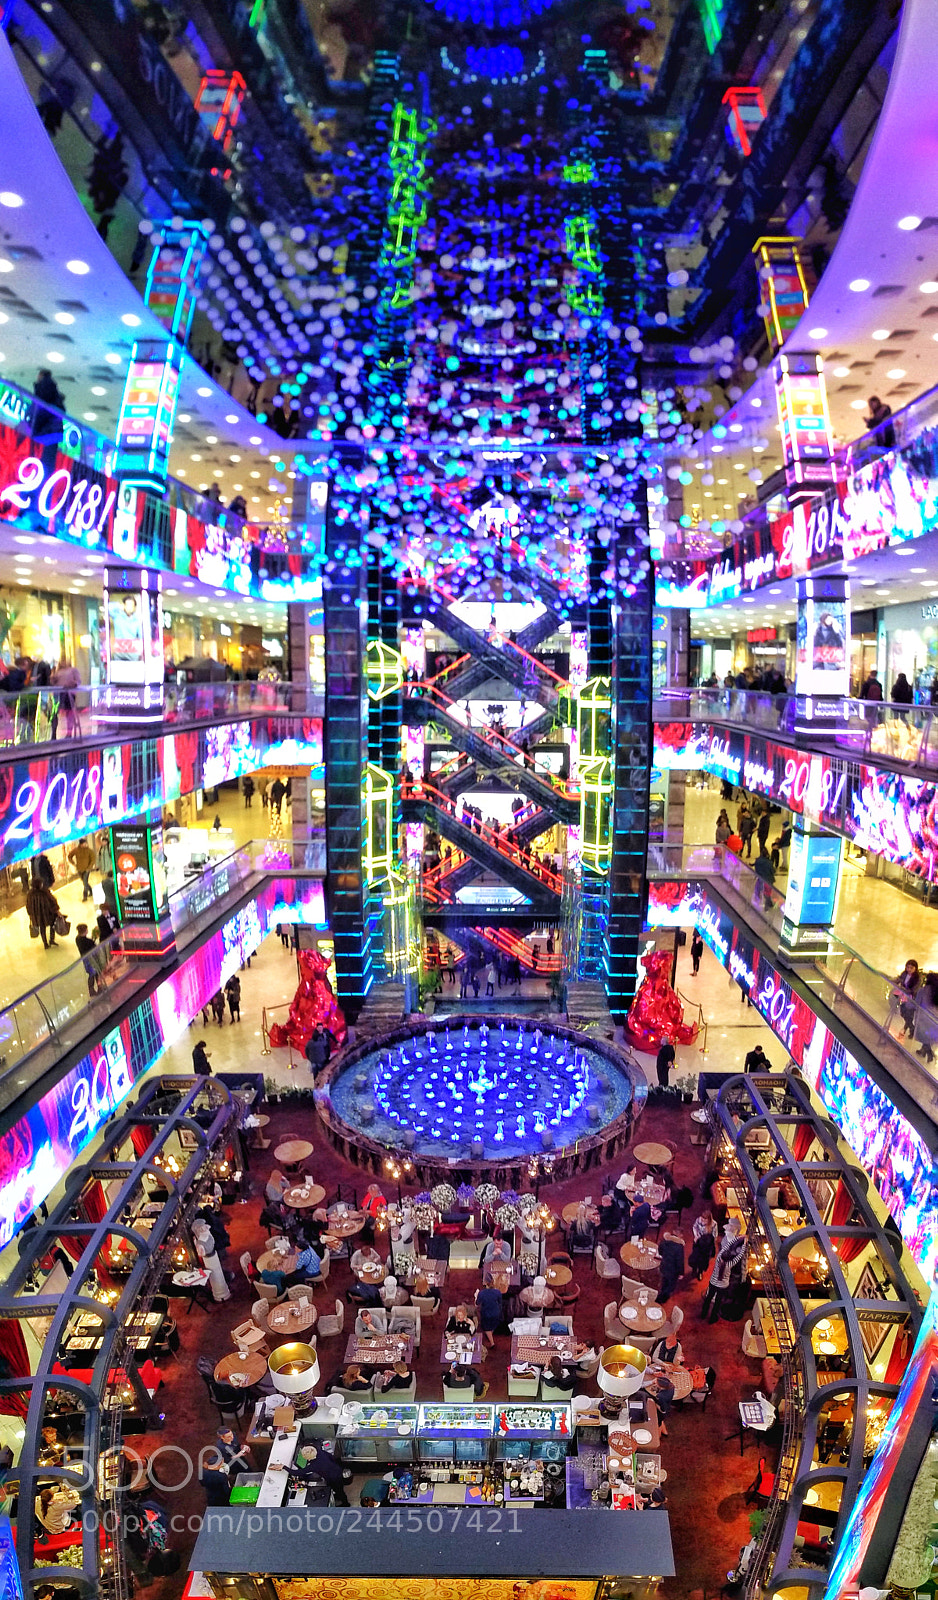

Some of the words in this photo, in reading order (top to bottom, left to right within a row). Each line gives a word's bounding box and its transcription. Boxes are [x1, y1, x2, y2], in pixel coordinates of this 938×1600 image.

[1, 457, 116, 533] 2018!
[4, 765, 101, 844] 2018
[9, 1307, 56, 1317] МОСКВА
[859, 1312, 901, 1321] ПАРИЖ
